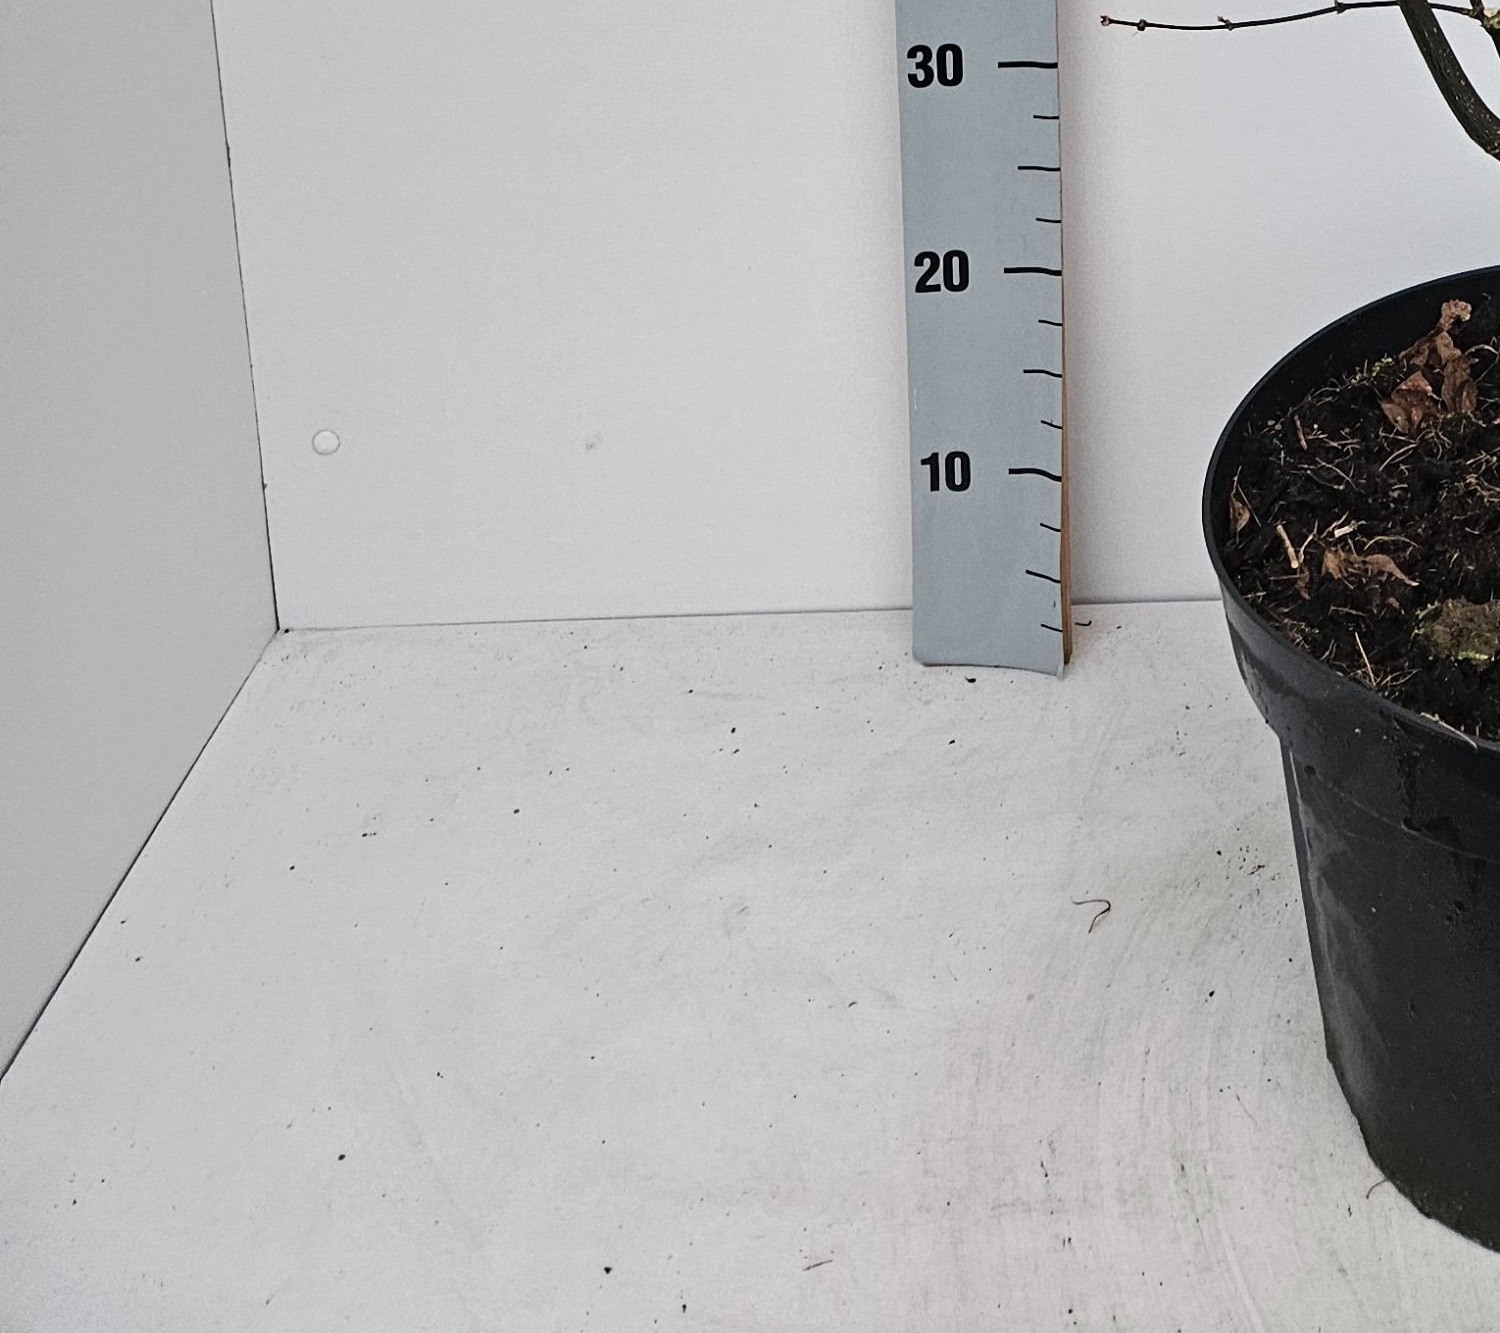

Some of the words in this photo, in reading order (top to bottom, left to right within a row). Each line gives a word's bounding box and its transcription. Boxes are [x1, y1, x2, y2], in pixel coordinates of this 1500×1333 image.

[907, 44, 964, 88] 30
[915, 250, 971, 294] 20
[921, 451, 973, 492] 10
